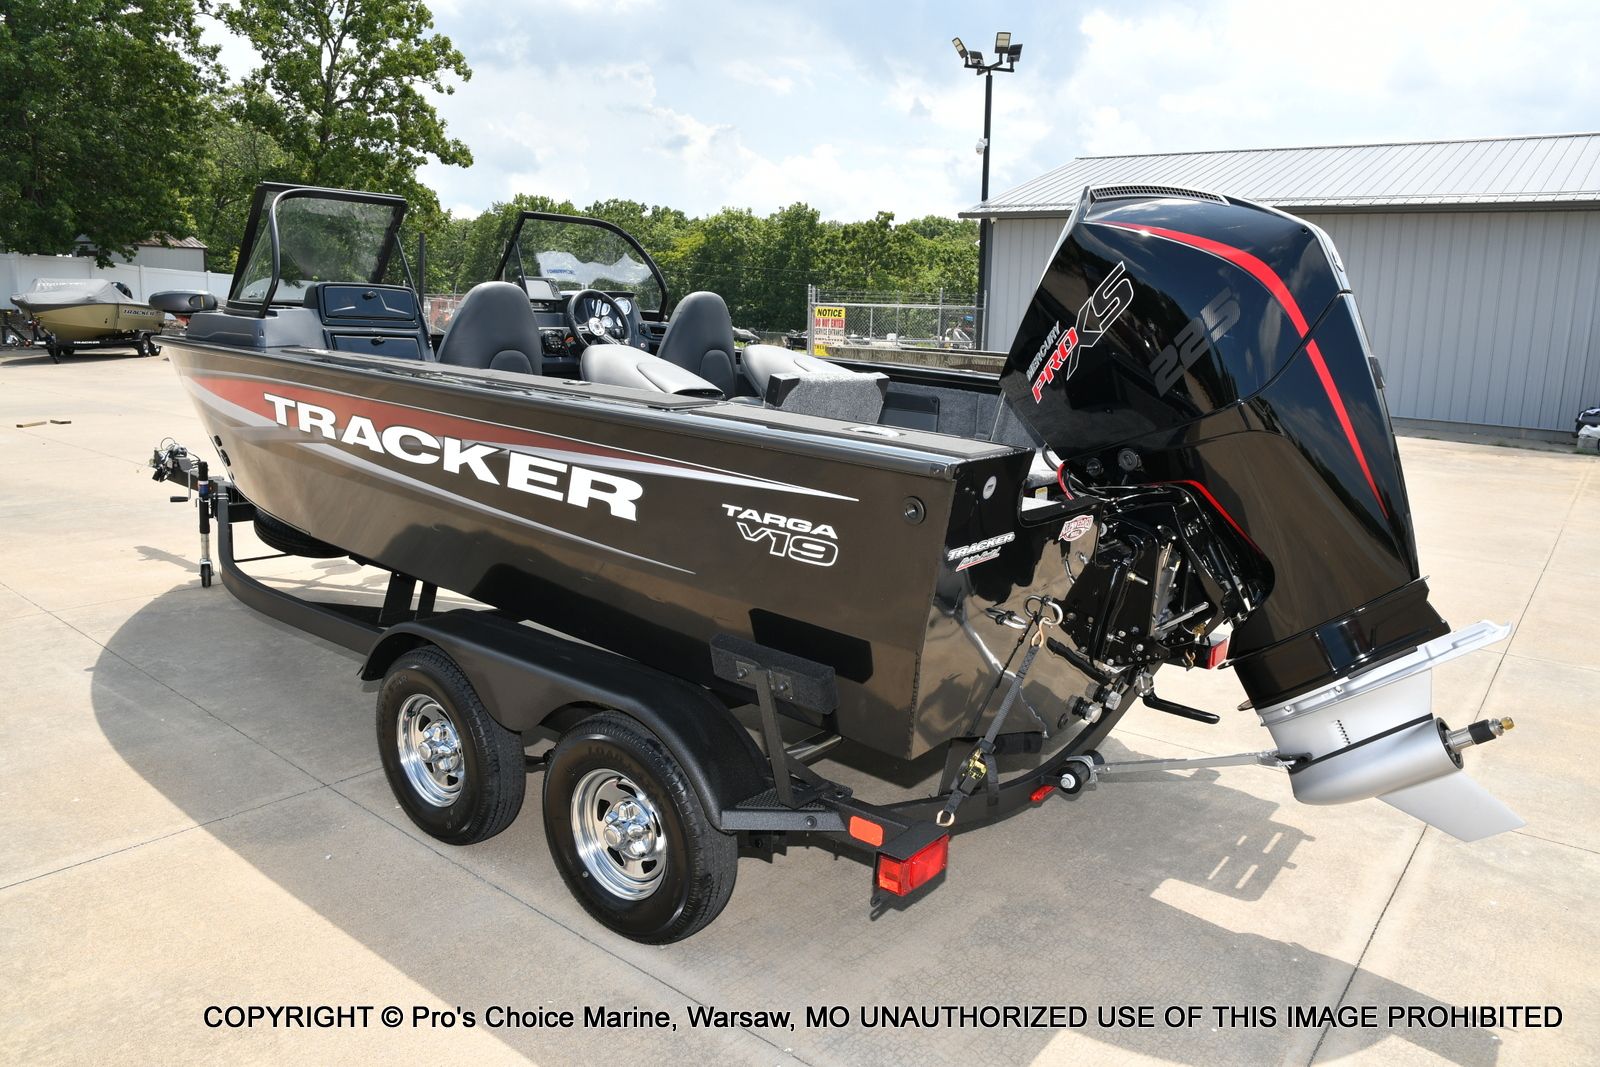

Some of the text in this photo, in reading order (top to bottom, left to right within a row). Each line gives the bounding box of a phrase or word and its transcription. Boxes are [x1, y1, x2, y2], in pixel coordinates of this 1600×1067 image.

[814, 328, 845, 337] SERVICE ENTRANCE
[815, 318, 844, 328] DO NOT ENTER
[817, 308, 842, 317] NOTICE
[1025, 320, 1061, 382] MERCURY
[1150, 286, 1241, 398] 225
[1031, 326, 1079, 404] PRO
[263, 392, 644, 522] TRACKER
[721, 503, 839, 540] TARGA
[735, 521, 839, 567] V19
[947, 531, 1016, 562] TRACKER
